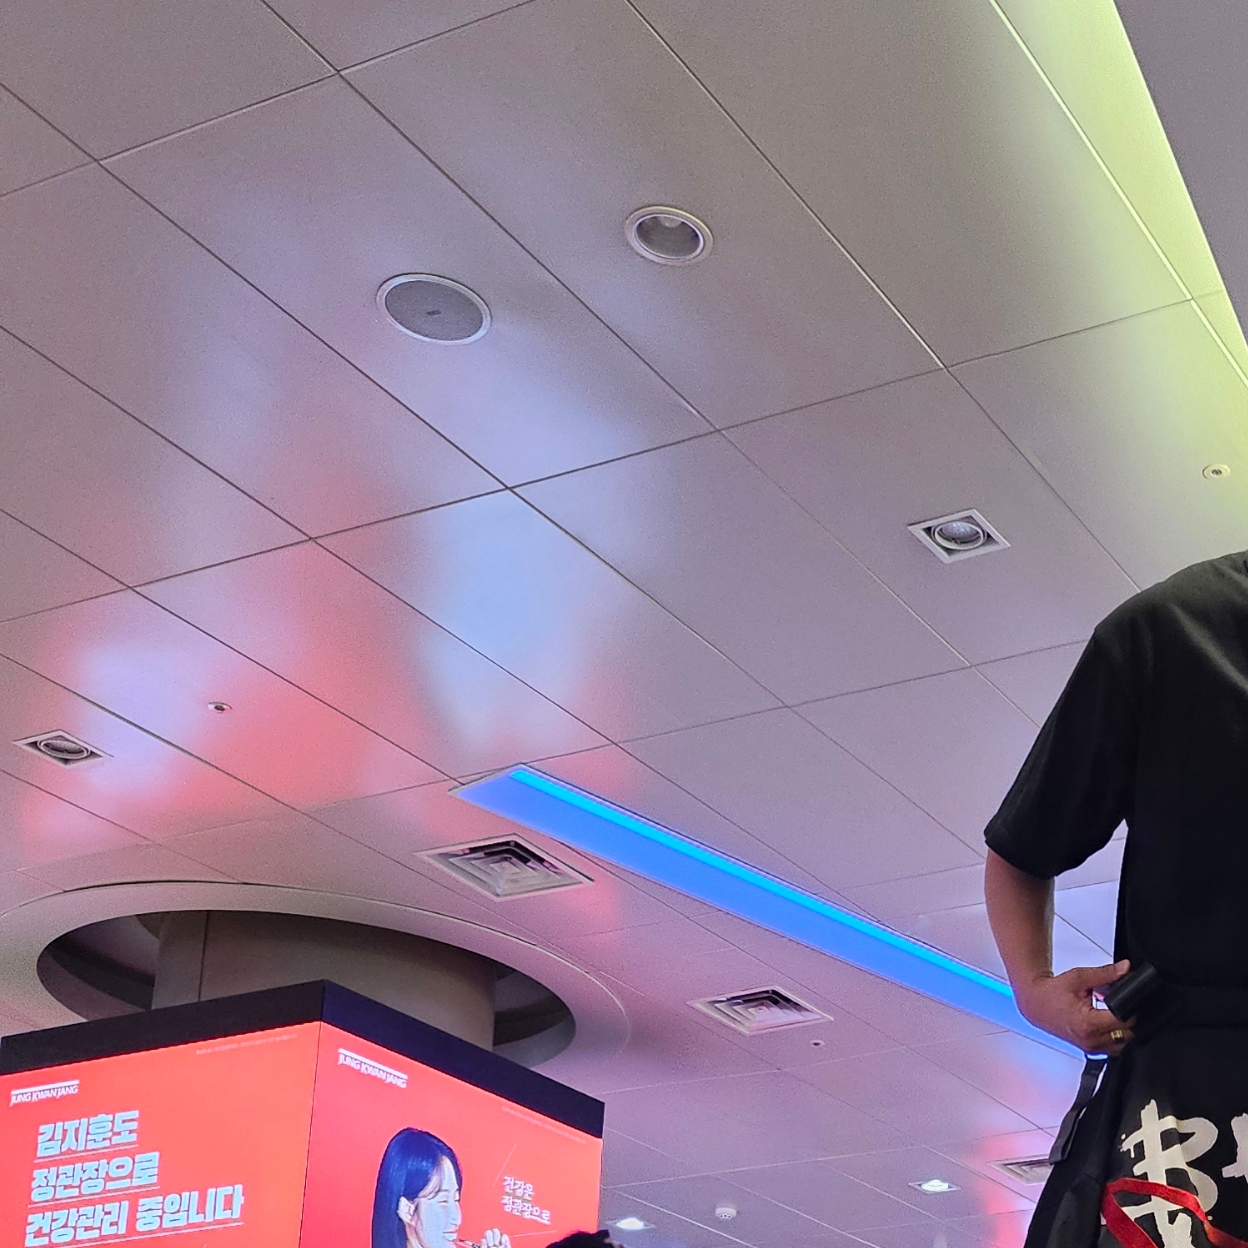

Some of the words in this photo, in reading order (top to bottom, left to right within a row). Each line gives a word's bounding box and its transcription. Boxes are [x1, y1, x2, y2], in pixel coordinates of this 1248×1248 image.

[36, 1110, 140, 1158] 김지훈도
[31, 1152, 160, 1203] 정관장으로
[503, 1176, 535, 1201] 건강은
[24, 1201, 130, 1248] 건강관리
[136, 1184, 245, 1232] 중입니다
[502, 1195, 552, 1226] 정관장으로
